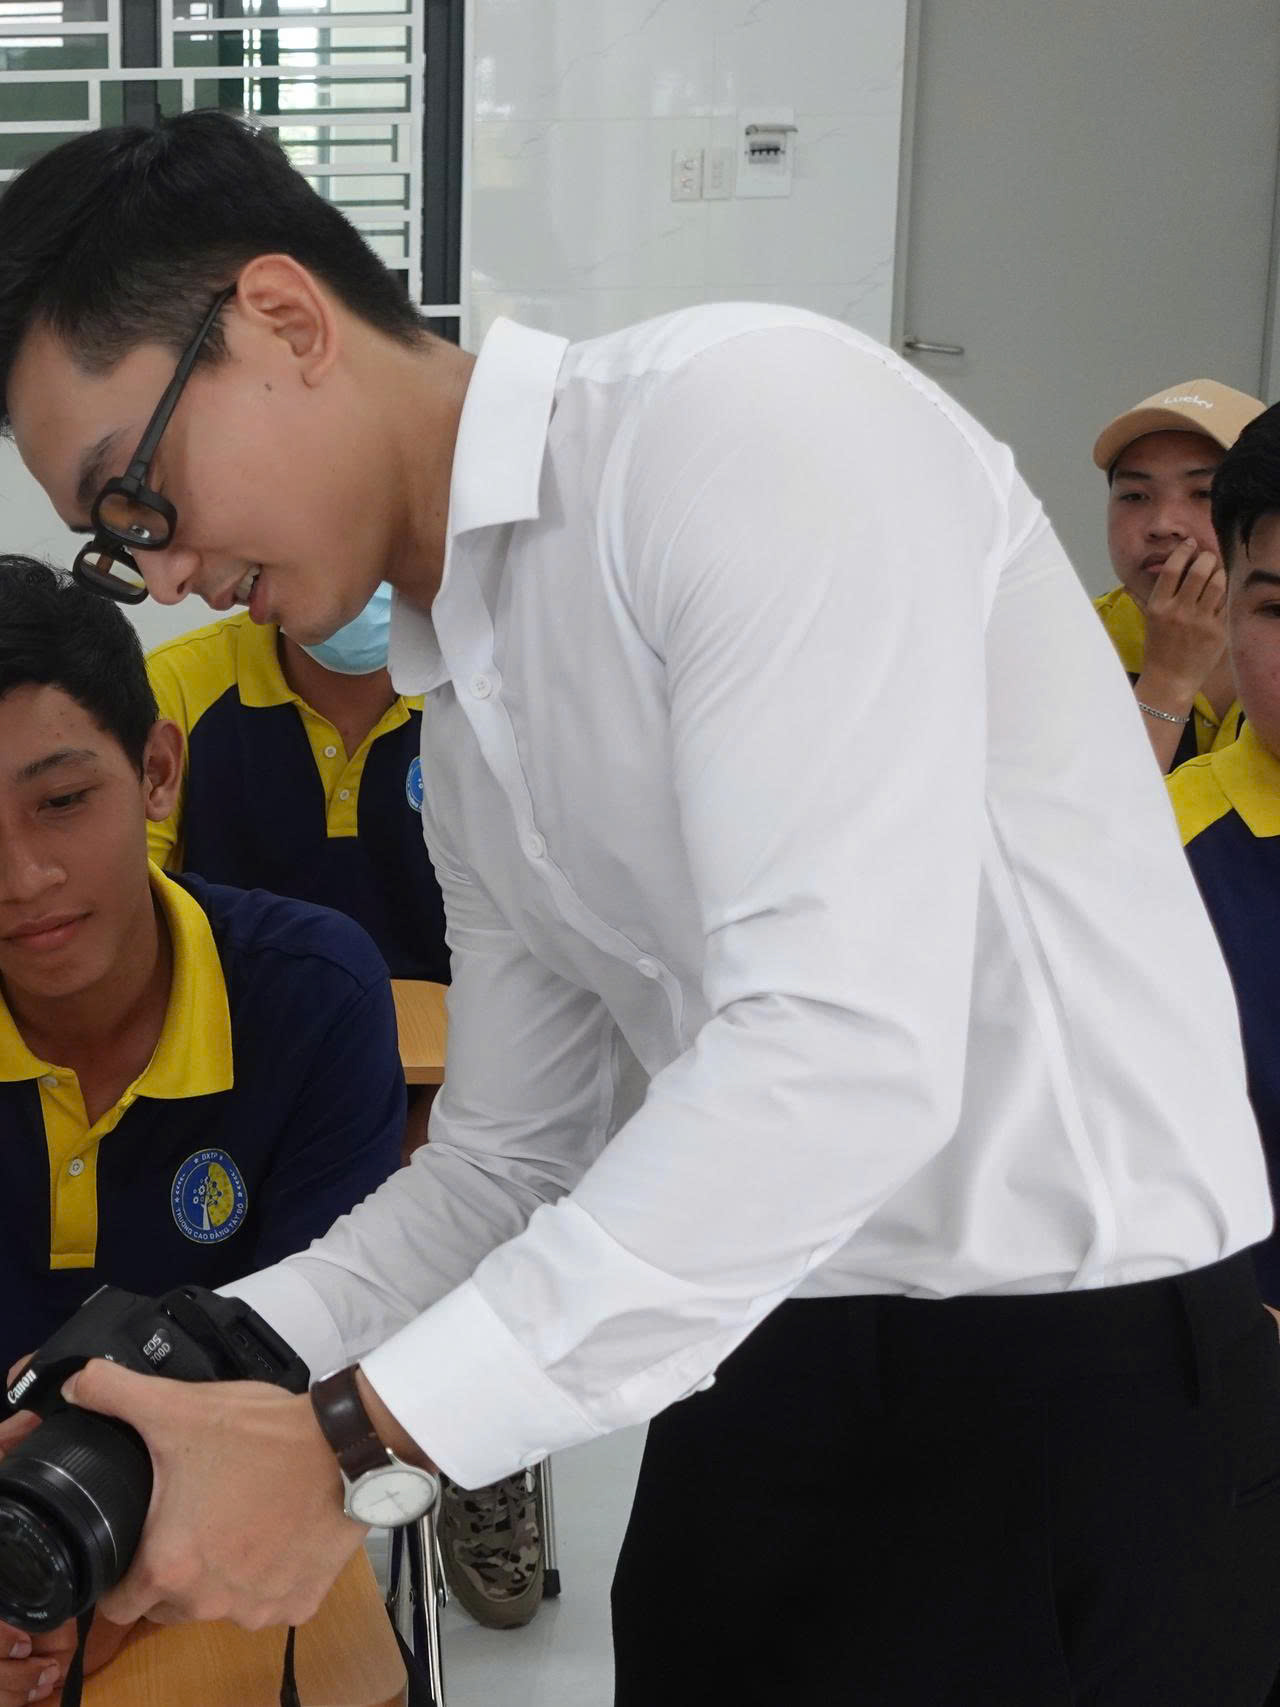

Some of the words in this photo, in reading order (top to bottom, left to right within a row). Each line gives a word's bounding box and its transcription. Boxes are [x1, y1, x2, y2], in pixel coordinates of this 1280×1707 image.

[193, 1232, 208, 1240] CAO
[143, 1334, 162, 1356] EOS
[150, 1342, 170, 1364] 700D
[7, 1369, 37, 1405] Canon
